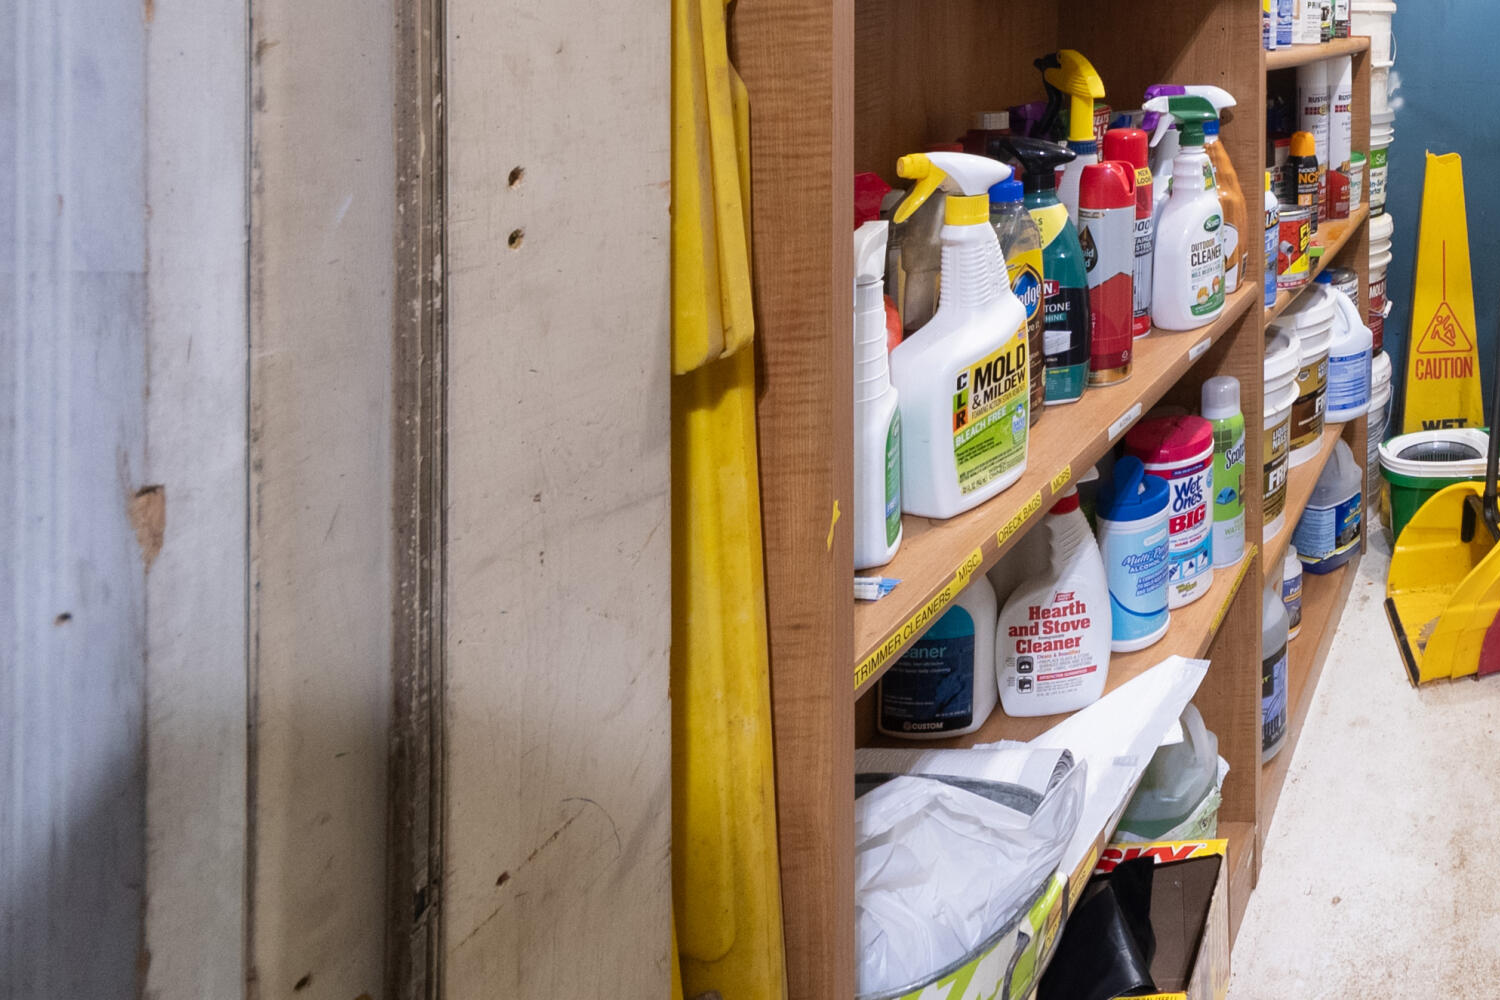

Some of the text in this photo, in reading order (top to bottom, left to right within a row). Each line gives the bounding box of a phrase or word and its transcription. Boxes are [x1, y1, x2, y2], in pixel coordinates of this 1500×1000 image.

[1190, 237, 1216, 253] OUTDOOR
[1190, 243, 1222, 267] CLEANER
[1044, 301, 1071, 313] TONE
[1044, 313, 1064, 322] HINE
[973, 343, 1026, 395] MOLD
[1415, 356, 1473, 380] CAUTION
[971, 367, 1026, 410] & MILDEW
[954, 416, 987, 448] BLEACH
[987, 406, 1008, 425] FREE
[1051, 466, 1072, 492] MOPS
[1174, 475, 1203, 500] Wet
[1172, 492, 1204, 515] Ones
[997, 493, 1042, 545] ORECK BAGS
[1168, 503, 1206, 536] BIG
[956, 552, 981, 584] MISC.
[1028, 599, 1087, 621] Hearth
[854, 586, 952, 686] TRIMMER CLEANERS
[1008, 616, 1092, 639] and Stove
[1015, 636, 1082, 655] Cleaner
[911, 721, 945, 731] CUSTOM
[1094, 844, 1201, 875] SKY
